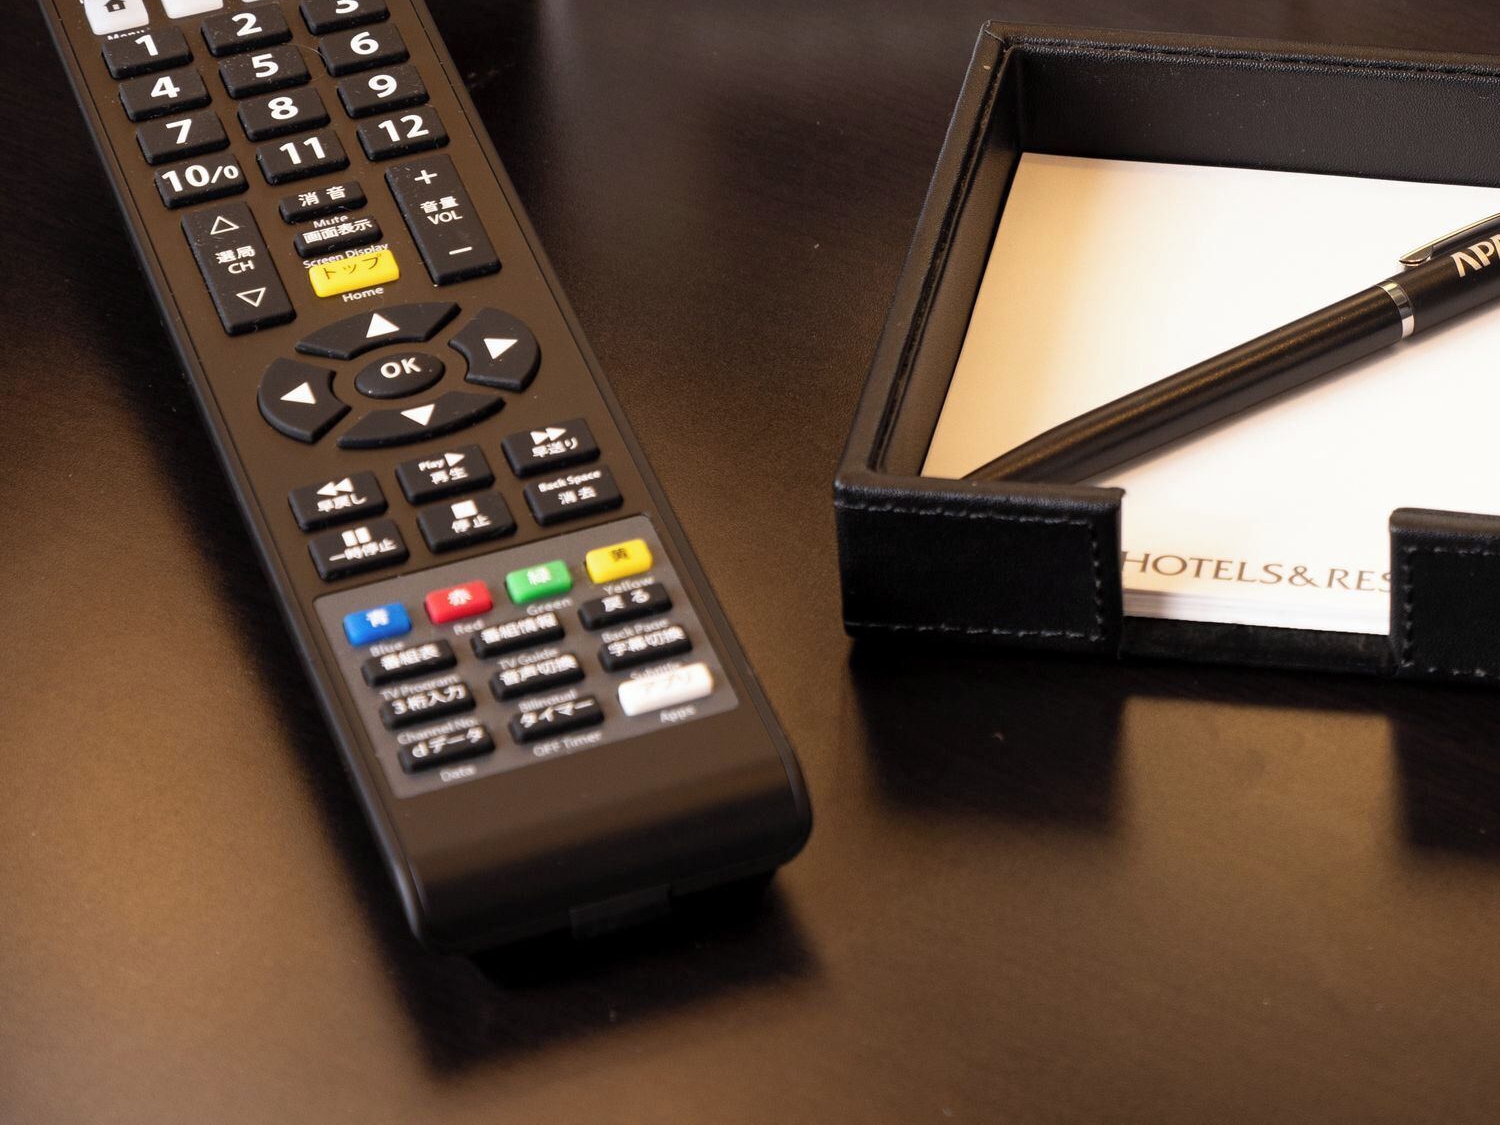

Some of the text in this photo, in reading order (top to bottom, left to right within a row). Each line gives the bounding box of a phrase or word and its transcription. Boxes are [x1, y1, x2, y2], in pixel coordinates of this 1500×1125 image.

[231, 13, 262, 36] 2
[134, 34, 159, 57] 1
[350, 31, 379, 55] 6
[251, 53, 279, 78] 5
[150, 76, 180, 99] 4
[368, 74, 397, 98] 9
[267, 96, 298, 120] 8
[165, 118, 193, 144] 7
[377, 114, 429, 142] 12
[279, 136, 326, 165] 11
[161, 163, 240, 193] 10/0
[420, 196, 460, 215] 音量
[313, 214, 349, 229] Mute
[427, 210, 463, 226] VOL
[303, 218, 373, 244] 画面表示
[214, 245, 256, 264] 選局
[302, 242, 389, 269] Screen Display
[227, 260, 256, 275] CH
[321, 252, 383, 280] トップ
[341, 285, 384, 303] Home
[380, 357, 421, 379] OK
[531, 436, 579, 458] 早送り
[417, 457, 445, 472] Play
[430, 466, 468, 484] 再生
[537, 469, 602, 493] Back Space
[316, 493, 367, 513] 早戻し
[557, 485, 598, 505] 消去
[451, 514, 492, 533] 停止
[328, 538, 397, 562] 一時停止
[603, 575, 655, 595] Yellow
[526, 596, 574, 616] Green
[453, 618, 485, 636] Red
[601, 625, 635, 644] Back
[369, 640, 405, 657] Blue
[497, 648, 559, 670] TV Guide
[379, 688, 400, 701] TV
[519, 698, 595, 728] タイマー
[660, 704, 696, 724] Apps
[397, 721, 454, 745] Channel
[562, 731, 603, 750] Timer
[439, 764, 477, 783] Data
